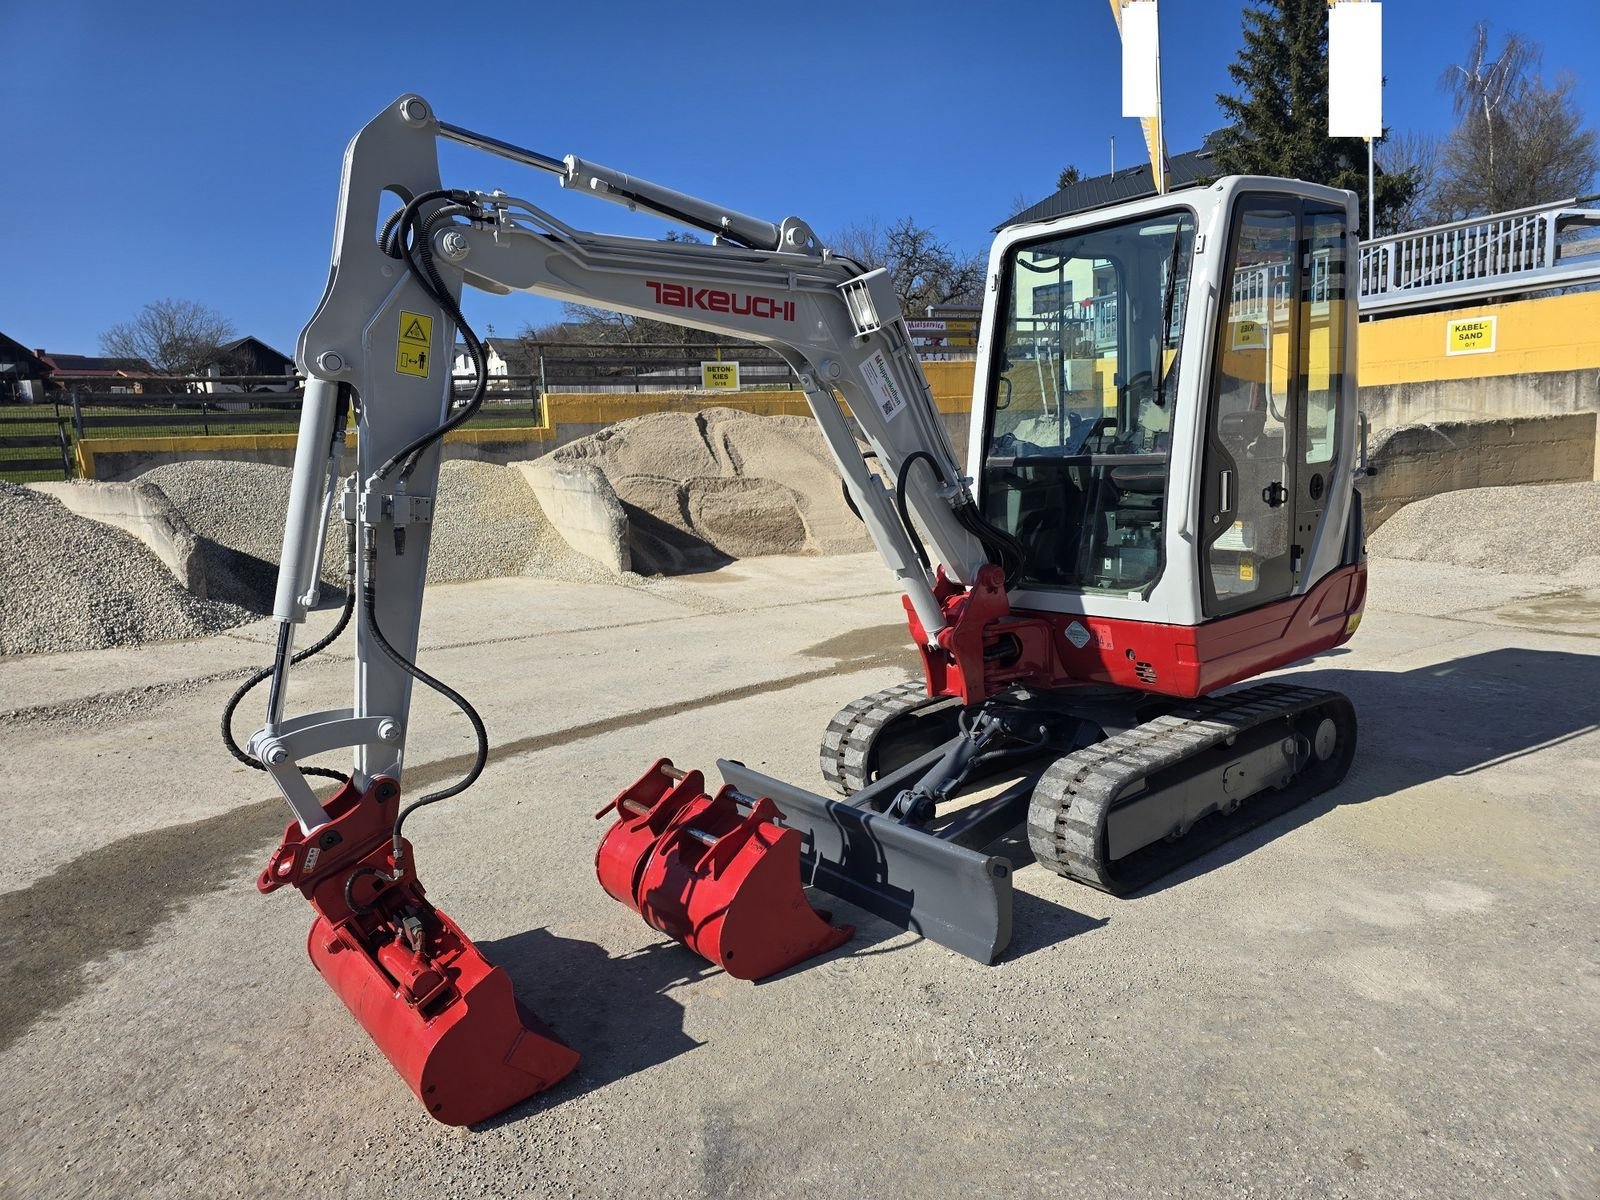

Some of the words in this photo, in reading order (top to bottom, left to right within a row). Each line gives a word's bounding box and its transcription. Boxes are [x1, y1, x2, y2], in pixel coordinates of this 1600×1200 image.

[646, 281, 795, 321] TAKEUCHI
[1455, 323, 1488, 332] KABEL-
[1458, 332, 1483, 340] SAND
